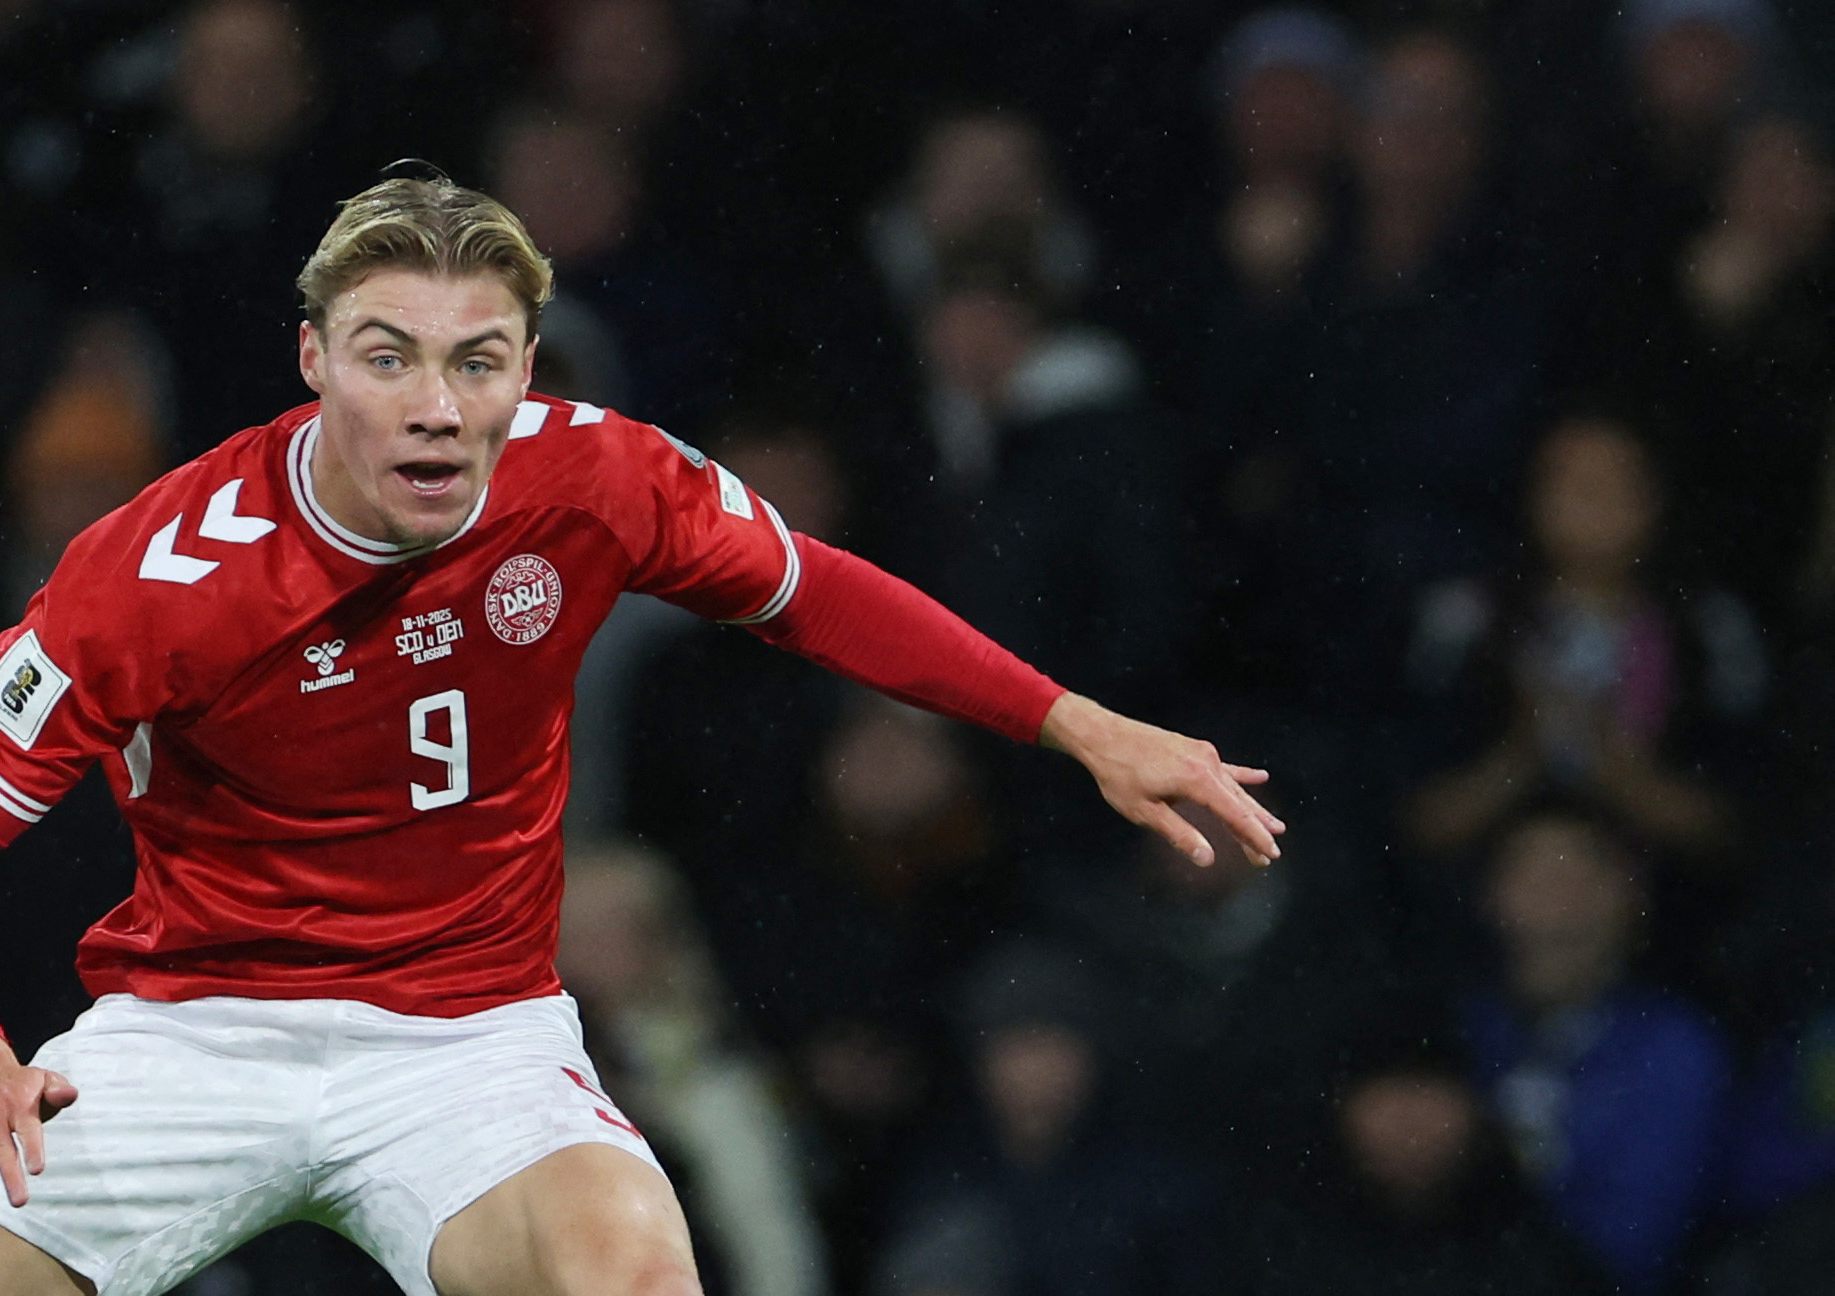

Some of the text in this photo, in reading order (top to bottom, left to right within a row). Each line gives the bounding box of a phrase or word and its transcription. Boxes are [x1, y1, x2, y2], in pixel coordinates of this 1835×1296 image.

[488, 593, 512, 639] DANSK
[545, 571, 559, 619] UNION
[500, 579, 548, 618] DBU
[401, 608, 453, 631] 18-11-2025
[436, 618, 464, 645] DEN
[412, 643, 452, 665] GLASGOW
[300, 668, 354, 693] hummel
[409, 689, 469, 811] 9
